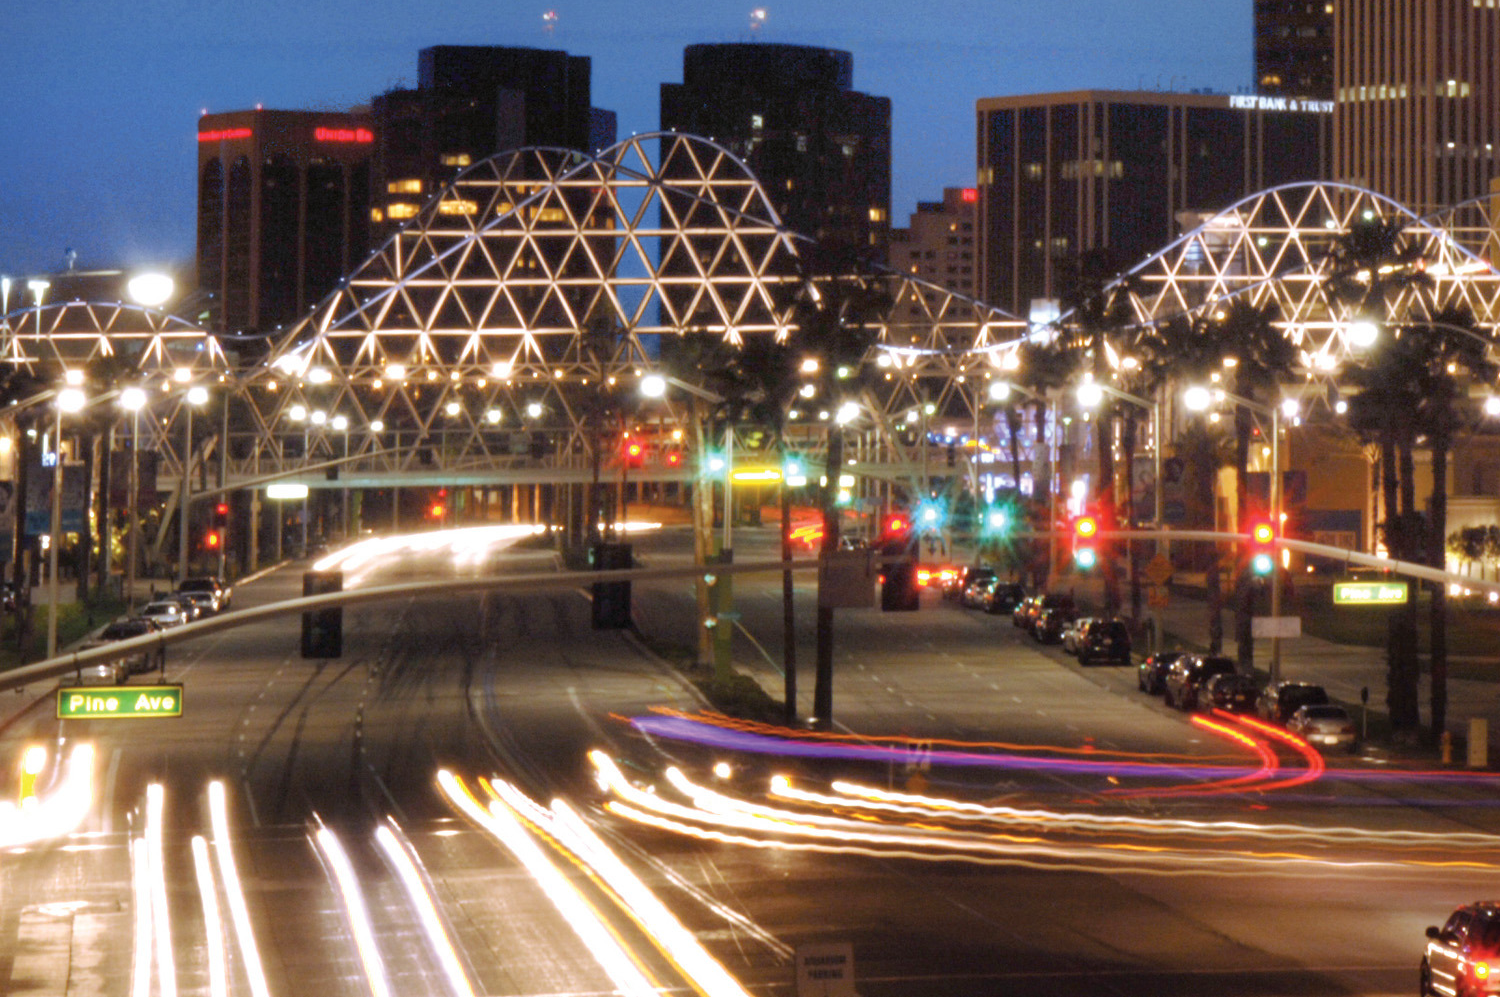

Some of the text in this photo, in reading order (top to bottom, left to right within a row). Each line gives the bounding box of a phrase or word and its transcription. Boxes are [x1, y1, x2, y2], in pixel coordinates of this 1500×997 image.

[1229, 95, 1258, 108] FIRST
[1258, 96, 1287, 110] BANK
[1300, 100, 1335, 113] TRUST
[69, 693, 175, 712] Pine Ave
